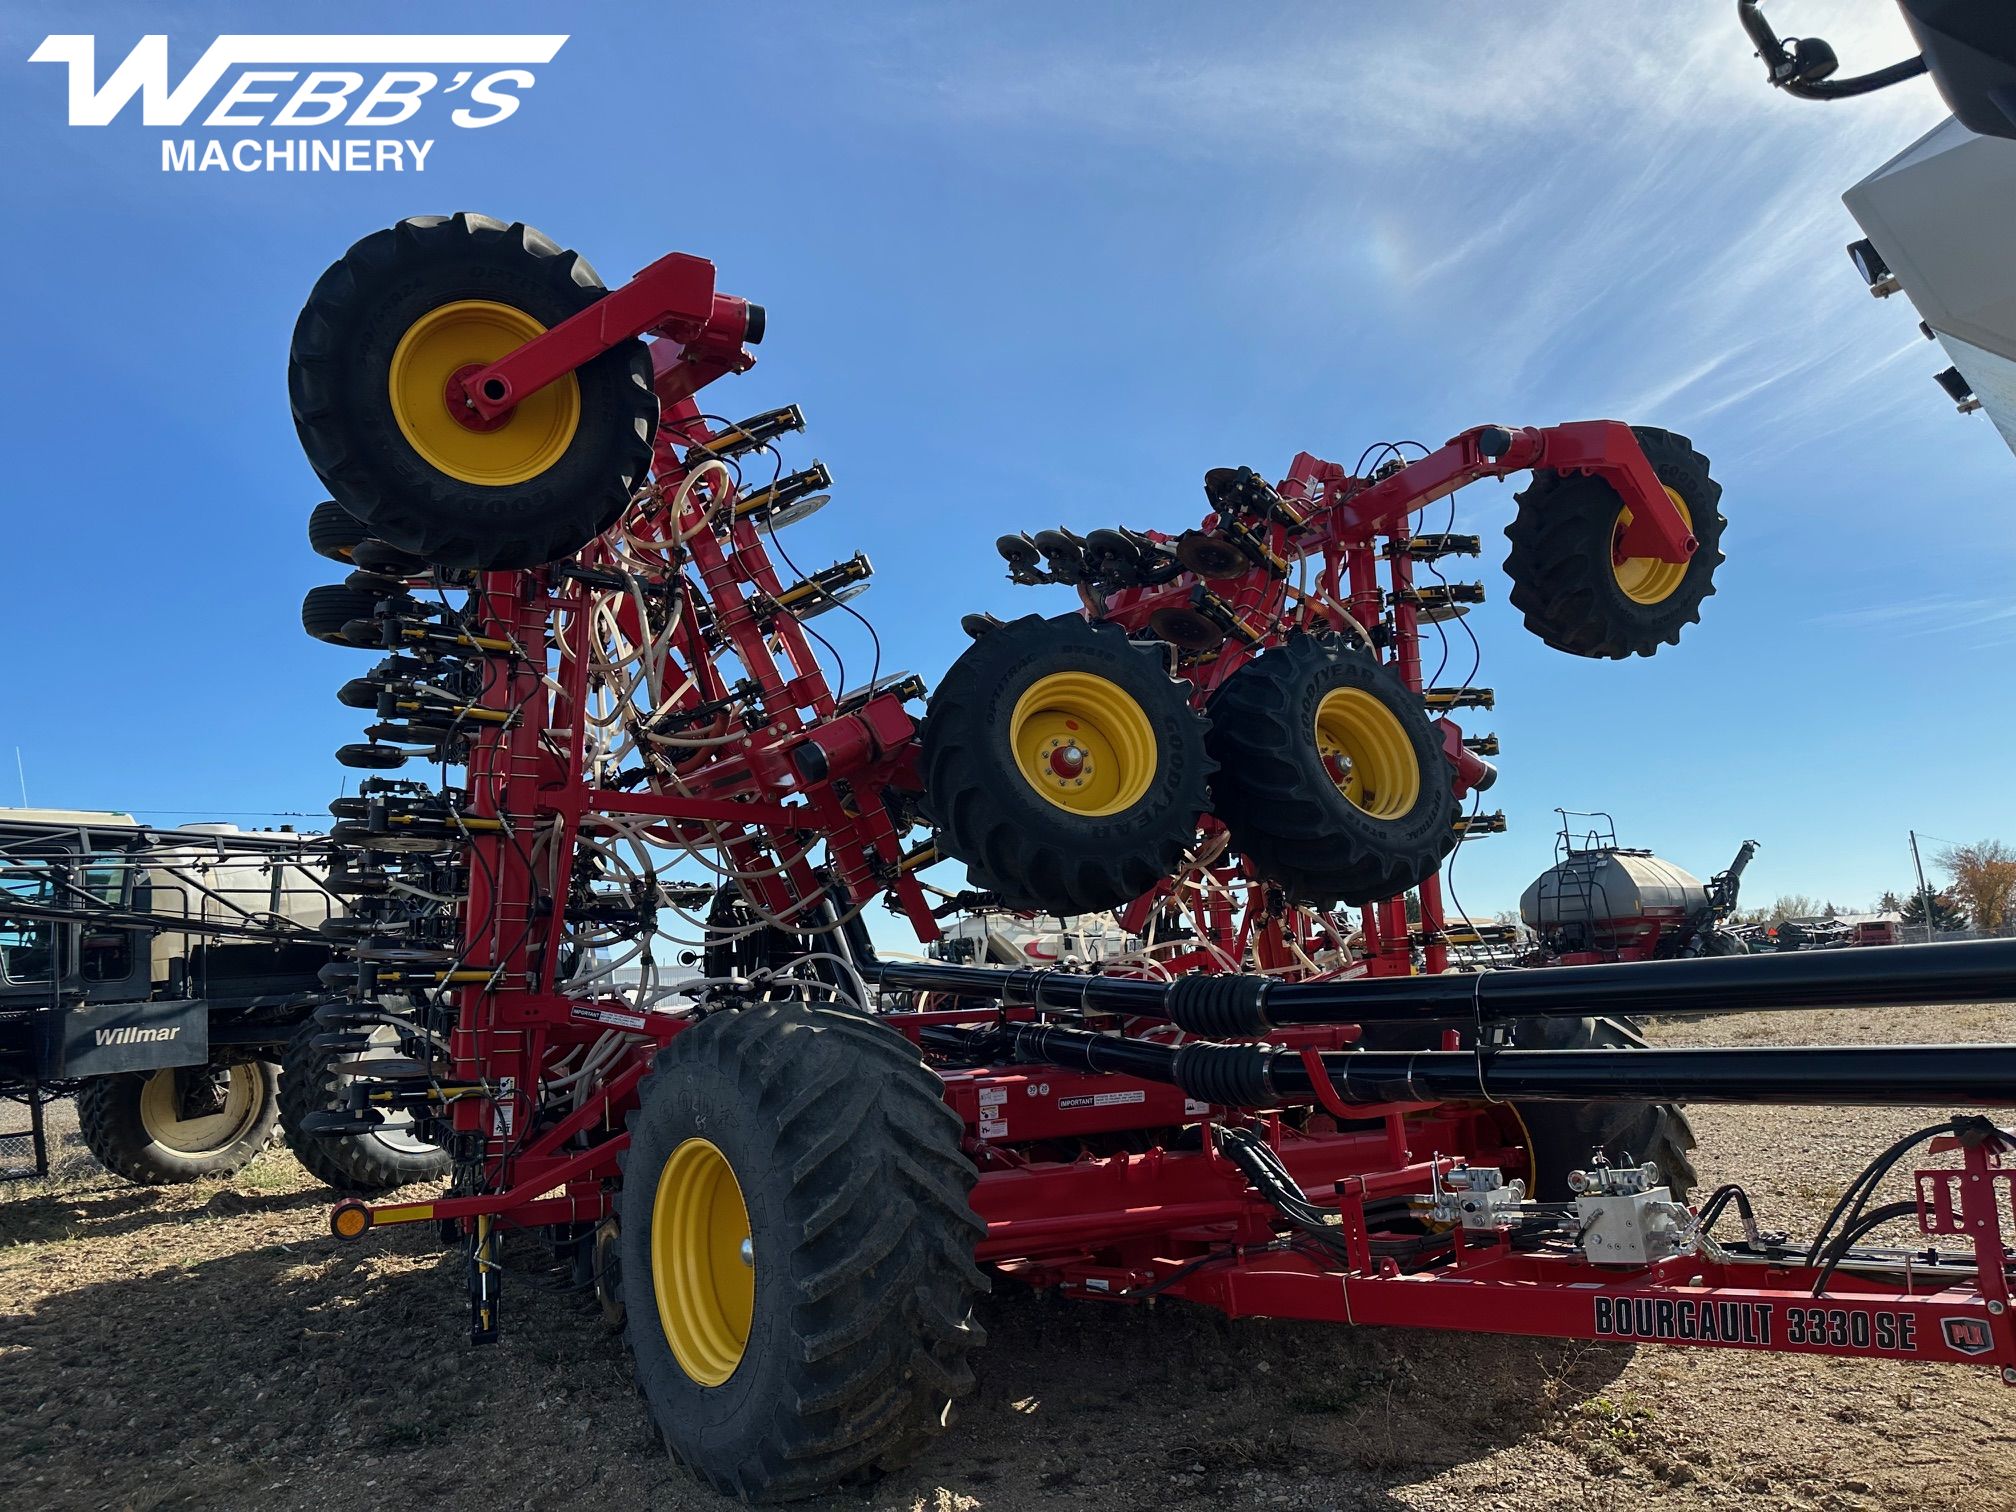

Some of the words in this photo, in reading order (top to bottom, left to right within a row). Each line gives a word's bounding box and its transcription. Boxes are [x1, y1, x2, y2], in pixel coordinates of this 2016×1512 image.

[986, 652, 1037, 727] OPTITRAC
[1301, 663, 1375, 747] GOODYEAR
[1092, 714, 1184, 840] GOODYEAR
[573, 1008, 600, 1018] IMPORTANT
[95, 1026, 181, 1046] Willmar
[1060, 1097, 1094, 1107] IMPORTANT
[1594, 1296, 1774, 1345] BOURGAULT
[1951, 1324, 1985, 1346] PLX
